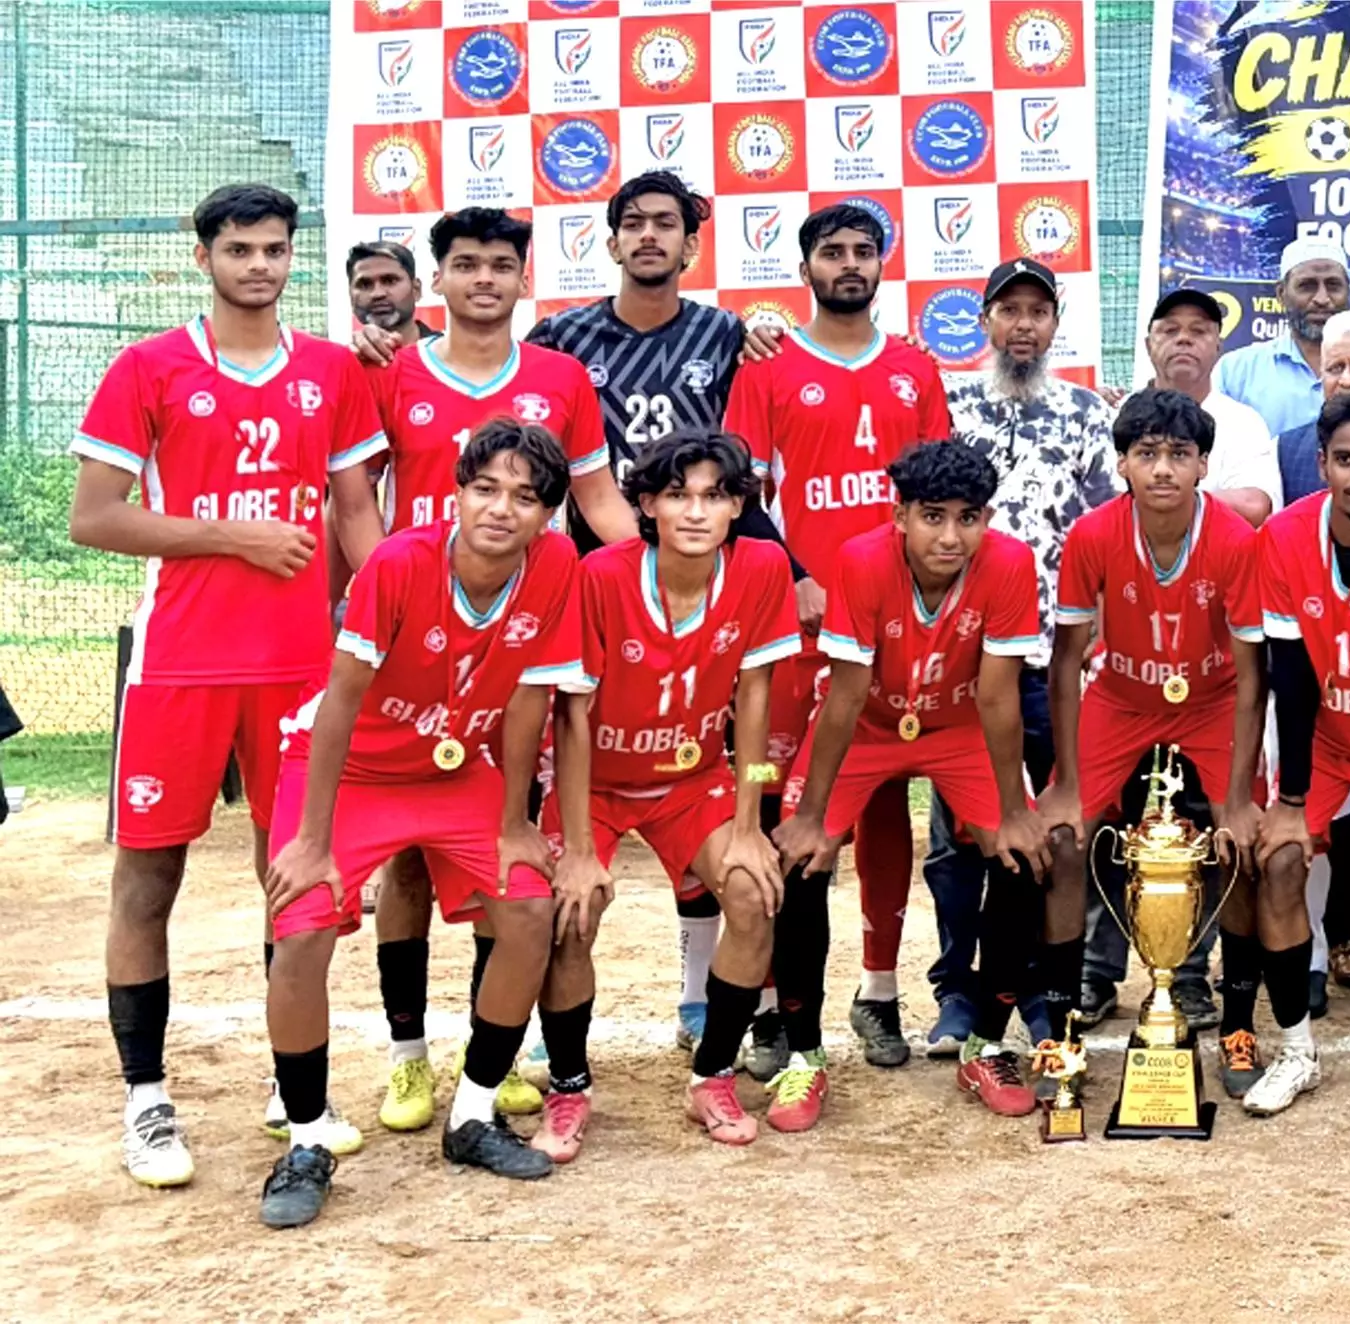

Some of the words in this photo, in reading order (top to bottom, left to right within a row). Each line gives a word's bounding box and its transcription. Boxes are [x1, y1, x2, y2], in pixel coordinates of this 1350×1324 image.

[1028, 40, 1051, 51] TFA
[653, 57, 676, 69] TFA
[749, 145, 772, 157] TFA
[386, 166, 408, 178] TFA
[1035, 228, 1058, 239] TFA
[1252, 296, 1286, 312] VEN
[625, 394, 674, 443] 23
[854, 404, 878, 455] 4
[235, 417, 281, 475] 22
[805, 471, 885, 511] GLOBE
[1149, 610, 1182, 652] 17
[1112, 652, 1190, 685] GLOBE
[658, 666, 697, 716] 11
[597, 723, 687, 753] GLOBE
